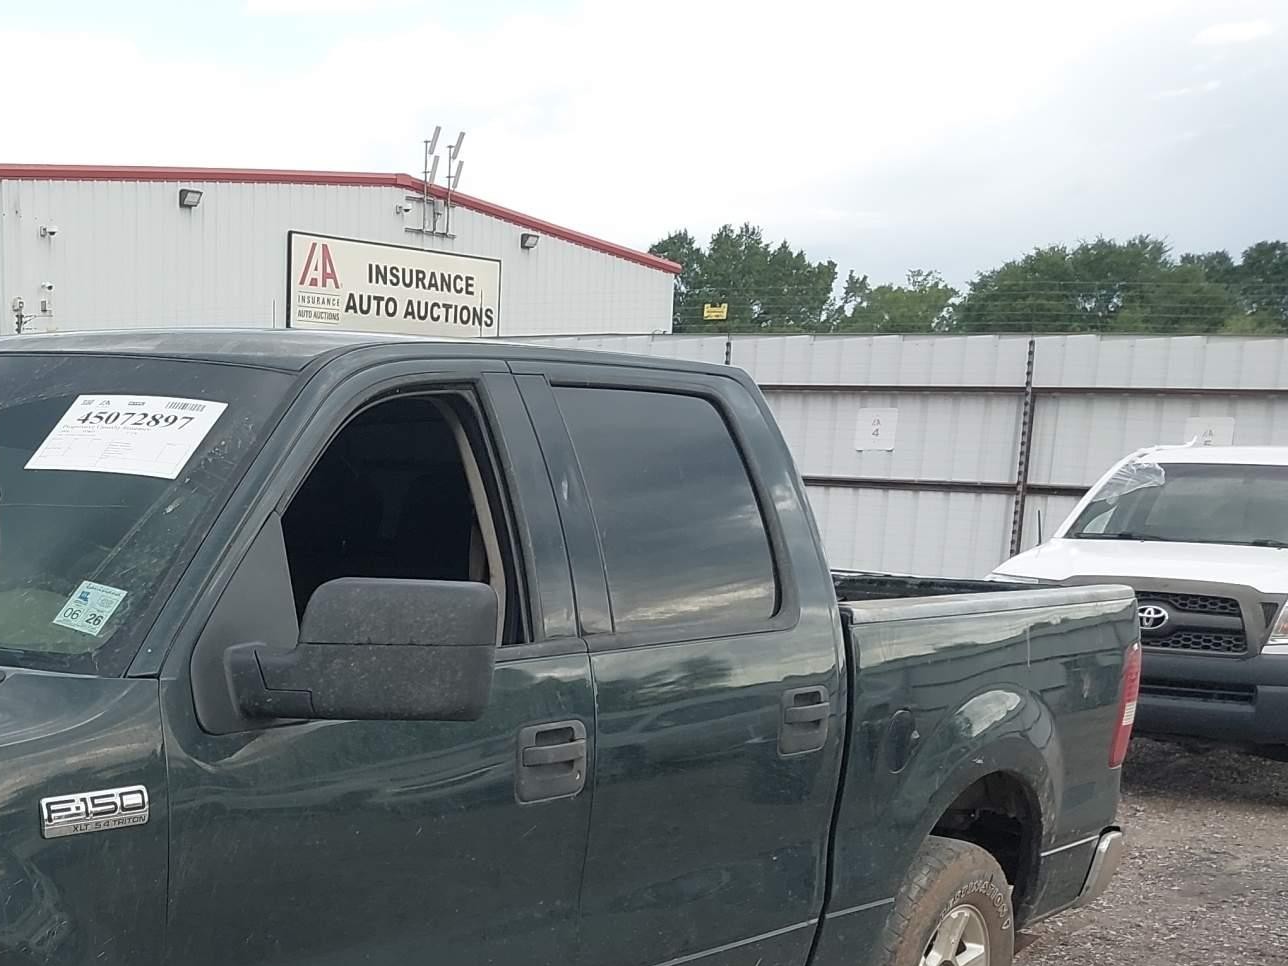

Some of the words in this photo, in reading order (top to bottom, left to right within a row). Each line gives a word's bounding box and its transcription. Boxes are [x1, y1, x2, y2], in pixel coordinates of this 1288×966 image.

[368, 263, 475, 296] INSURANCE
[297, 295, 340, 307] INSURANCE
[344, 293, 398, 318] AUTO
[403, 299, 494, 328] AUCTIONS
[297, 309, 312, 319] AUTO
[313, 311, 340, 321] AUCTIONS
[76, 410, 196, 431] 45072897
[63, 607, 82, 620] 06
[84, 613, 104, 626] 26
[72, 822, 91, 833] XLT
[113, 815, 147, 827] TRITON
